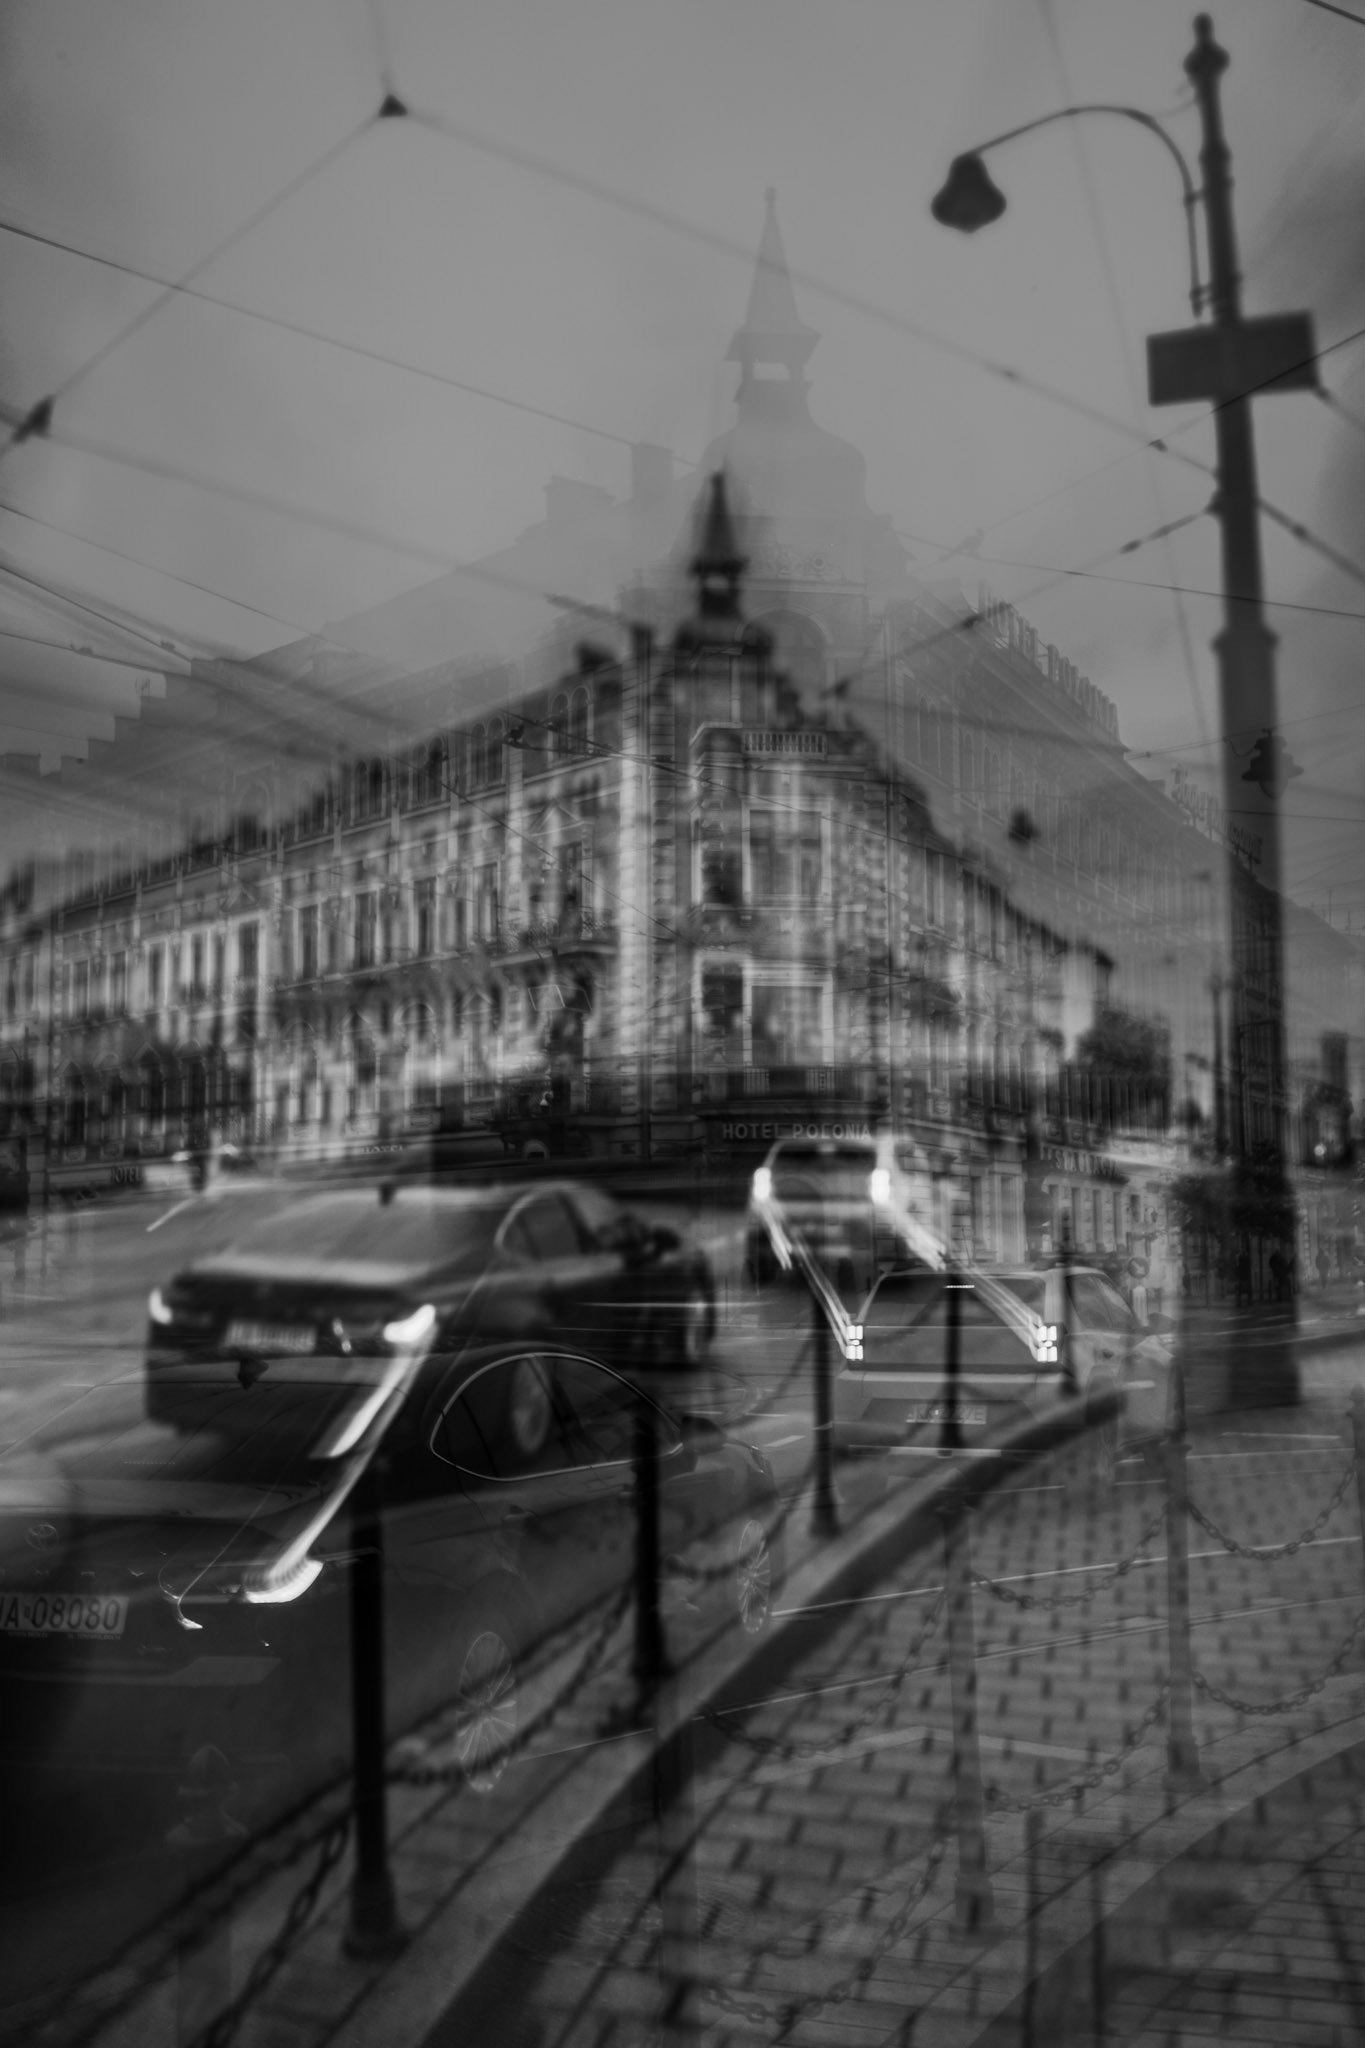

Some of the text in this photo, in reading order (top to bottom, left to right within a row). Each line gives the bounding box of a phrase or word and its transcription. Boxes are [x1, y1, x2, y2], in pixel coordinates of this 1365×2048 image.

[722, 1122, 870, 1141] HOTEL POLONIA
[108, 1165, 142, 1184] HOTEL
[31, 1596, 121, 1631] 08080
